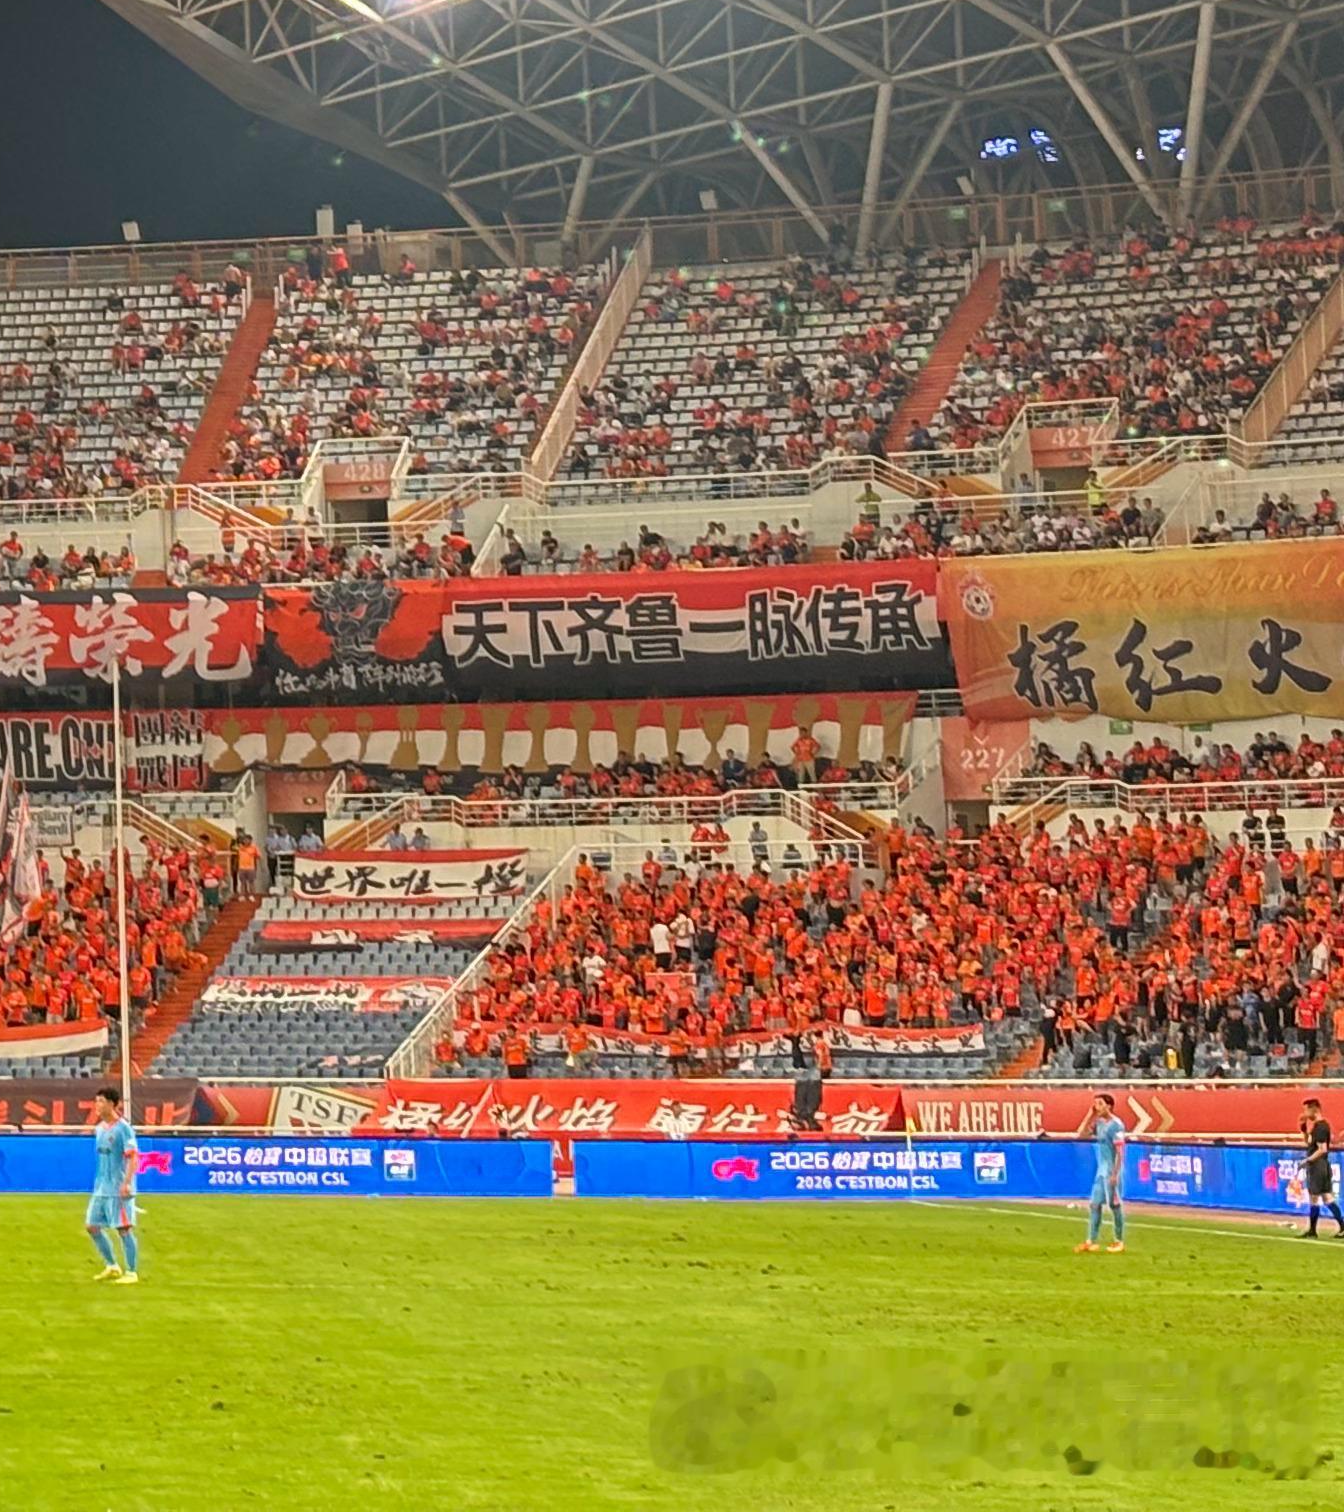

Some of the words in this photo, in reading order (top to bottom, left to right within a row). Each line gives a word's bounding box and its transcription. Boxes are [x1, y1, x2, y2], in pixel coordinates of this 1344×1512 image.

[452, 580, 934, 669] 天下齐鲁一脉传承
[960, 749, 1005, 771] 227
[917, 1100, 953, 1133] WE
[957, 1100, 998, 1133] ARE
[999, 1100, 1044, 1133] ONE
[208, 1170, 244, 1185] 2026
[247, 1170, 319, 1186] C'ESTBON
[322, 1170, 350, 1186] CSL
[796, 1175, 831, 1189] 2026
[835, 1174, 909, 1190] C'ESTBON
[912, 1175, 939, 1189] CSL
